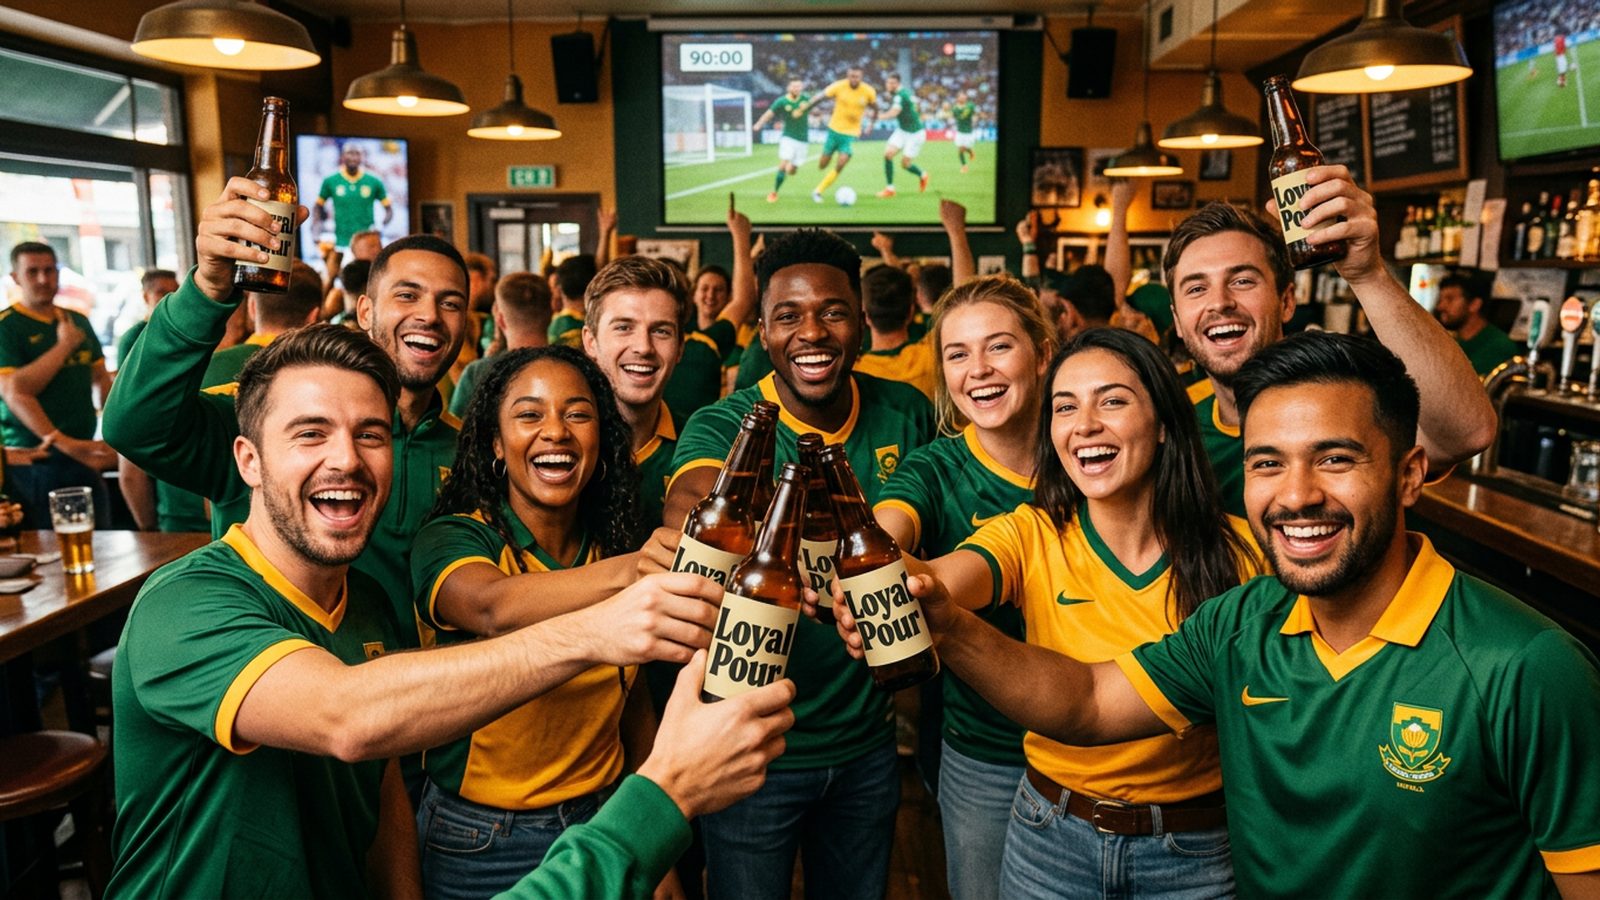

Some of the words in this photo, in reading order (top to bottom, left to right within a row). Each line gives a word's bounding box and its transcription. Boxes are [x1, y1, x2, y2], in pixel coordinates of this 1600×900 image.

[690, 50, 743, 65] 90:00
[1280, 207, 1313, 232] Po
[843, 571, 916, 620] Loyal
[715, 606, 795, 657] Loyal
[857, 610, 921, 651] Pour
[709, 642, 783, 688] Pour
